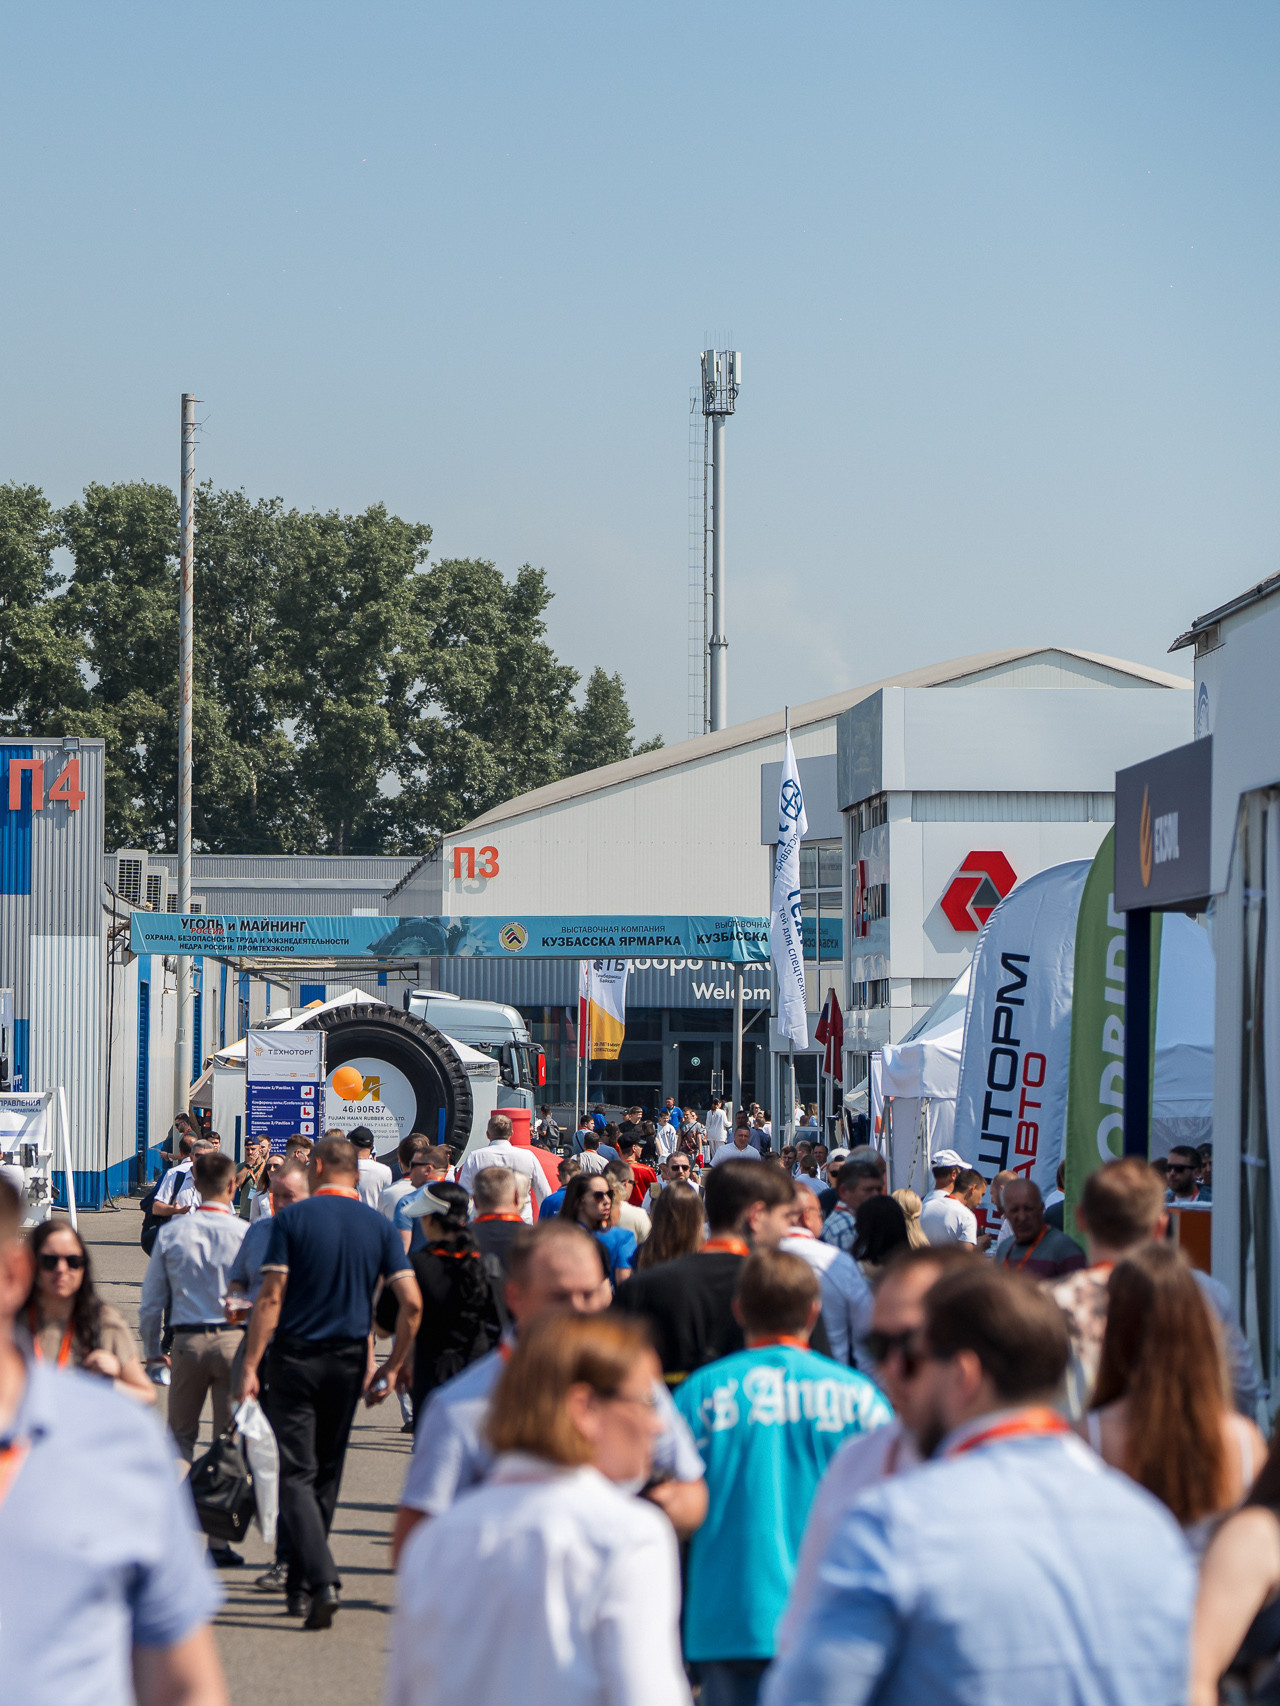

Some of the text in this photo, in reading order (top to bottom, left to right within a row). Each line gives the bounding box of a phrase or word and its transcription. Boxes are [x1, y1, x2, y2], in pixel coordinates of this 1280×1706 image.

[8, 758, 86, 811] П4
[453, 844, 500, 879] П3
[180, 917, 307, 933] УГОЛЬ и МАЙНИНГ
[561, 924, 666, 934] ВЫСТАВОЧНАЯ КОМПАНИЯ
[144, 933, 177, 943] ОХРАНА,
[177, 935, 235, 943] БЕЗОПАСНОСТЬ
[235, 936, 259, 944] ТРУДА
[266, 937, 350, 946] ЖИЗНЕДЕЯТЕЛЬНОСТИ
[541, 935, 681, 947] КУЗБАССКА ЯРМАРКА
[179, 943, 202, 951] НЕДРА
[237, 944, 295, 952] ПРОМТЕХЭКСПО
[787, 948, 807, 1014] спецтехни
[978, 951, 1031, 1186] ШТОРМ
[342, 1105, 386, 1114] 46/90R57
